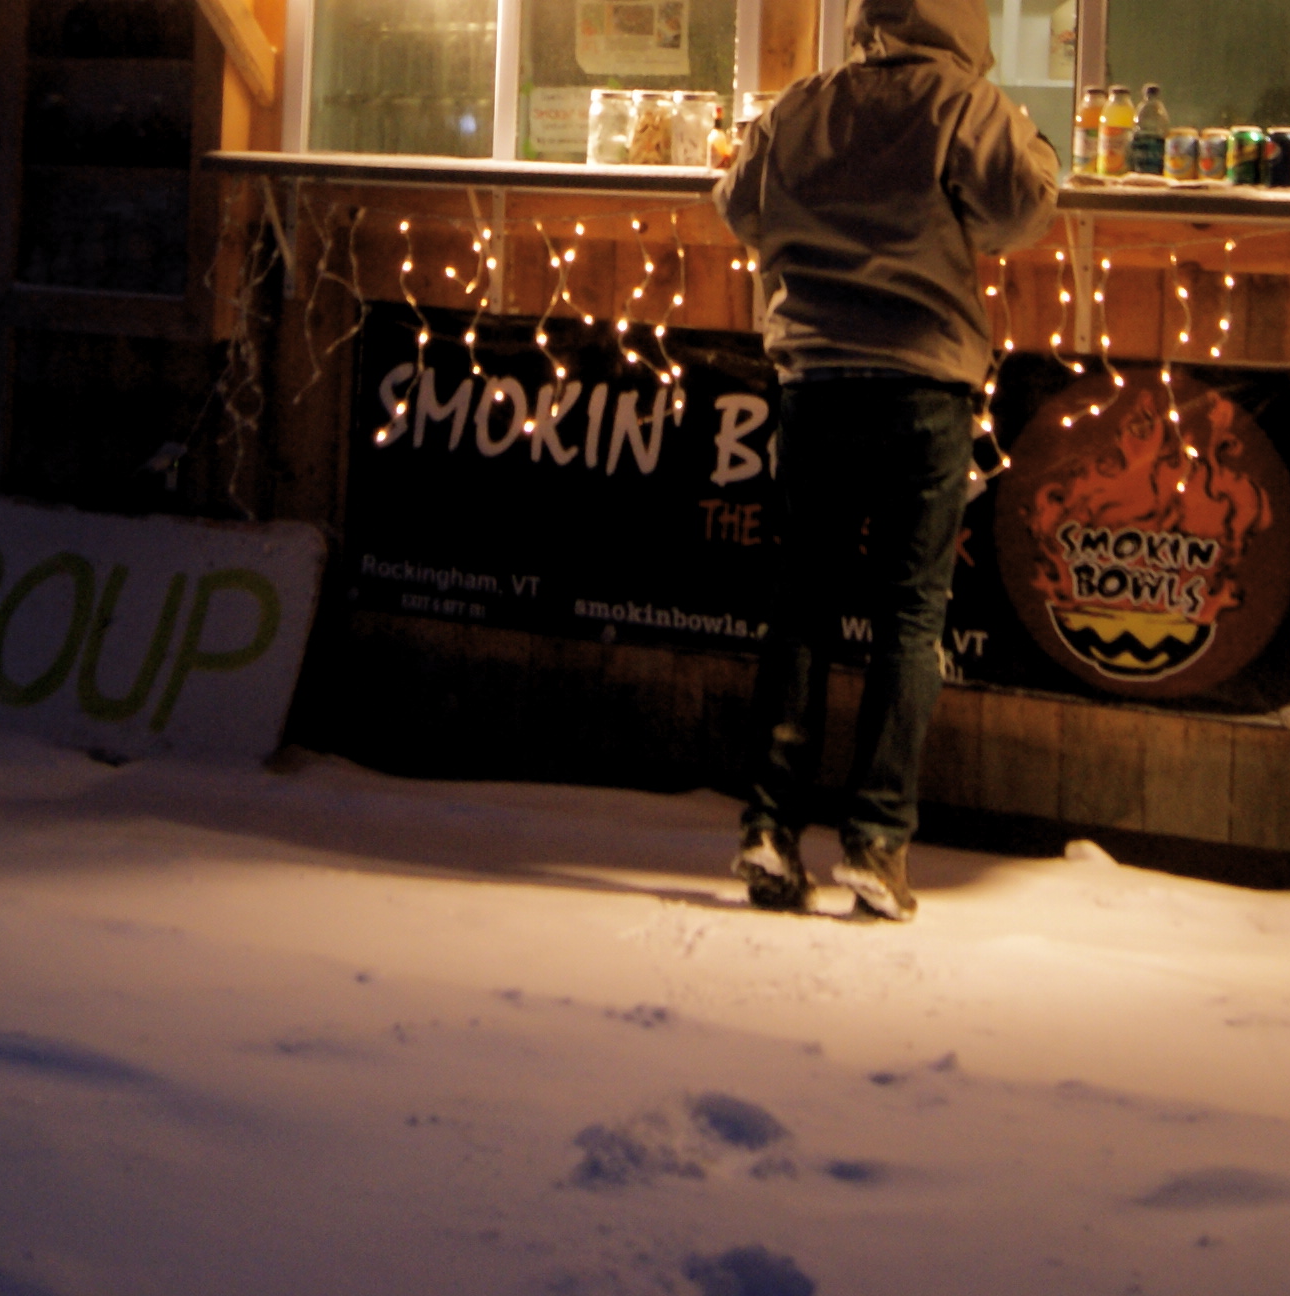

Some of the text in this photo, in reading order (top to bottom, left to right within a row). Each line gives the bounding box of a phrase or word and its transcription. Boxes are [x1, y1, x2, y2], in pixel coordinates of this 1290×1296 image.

[372, 361, 688, 476] SMOKIN'
[698, 498, 763, 546] THE
[1058, 520, 1221, 572] SMOKIN
[360, 552, 541, 599] Rockingham, VT
[1069, 561, 1208, 619] BOWLS
[951, 626, 990, 659] VT
